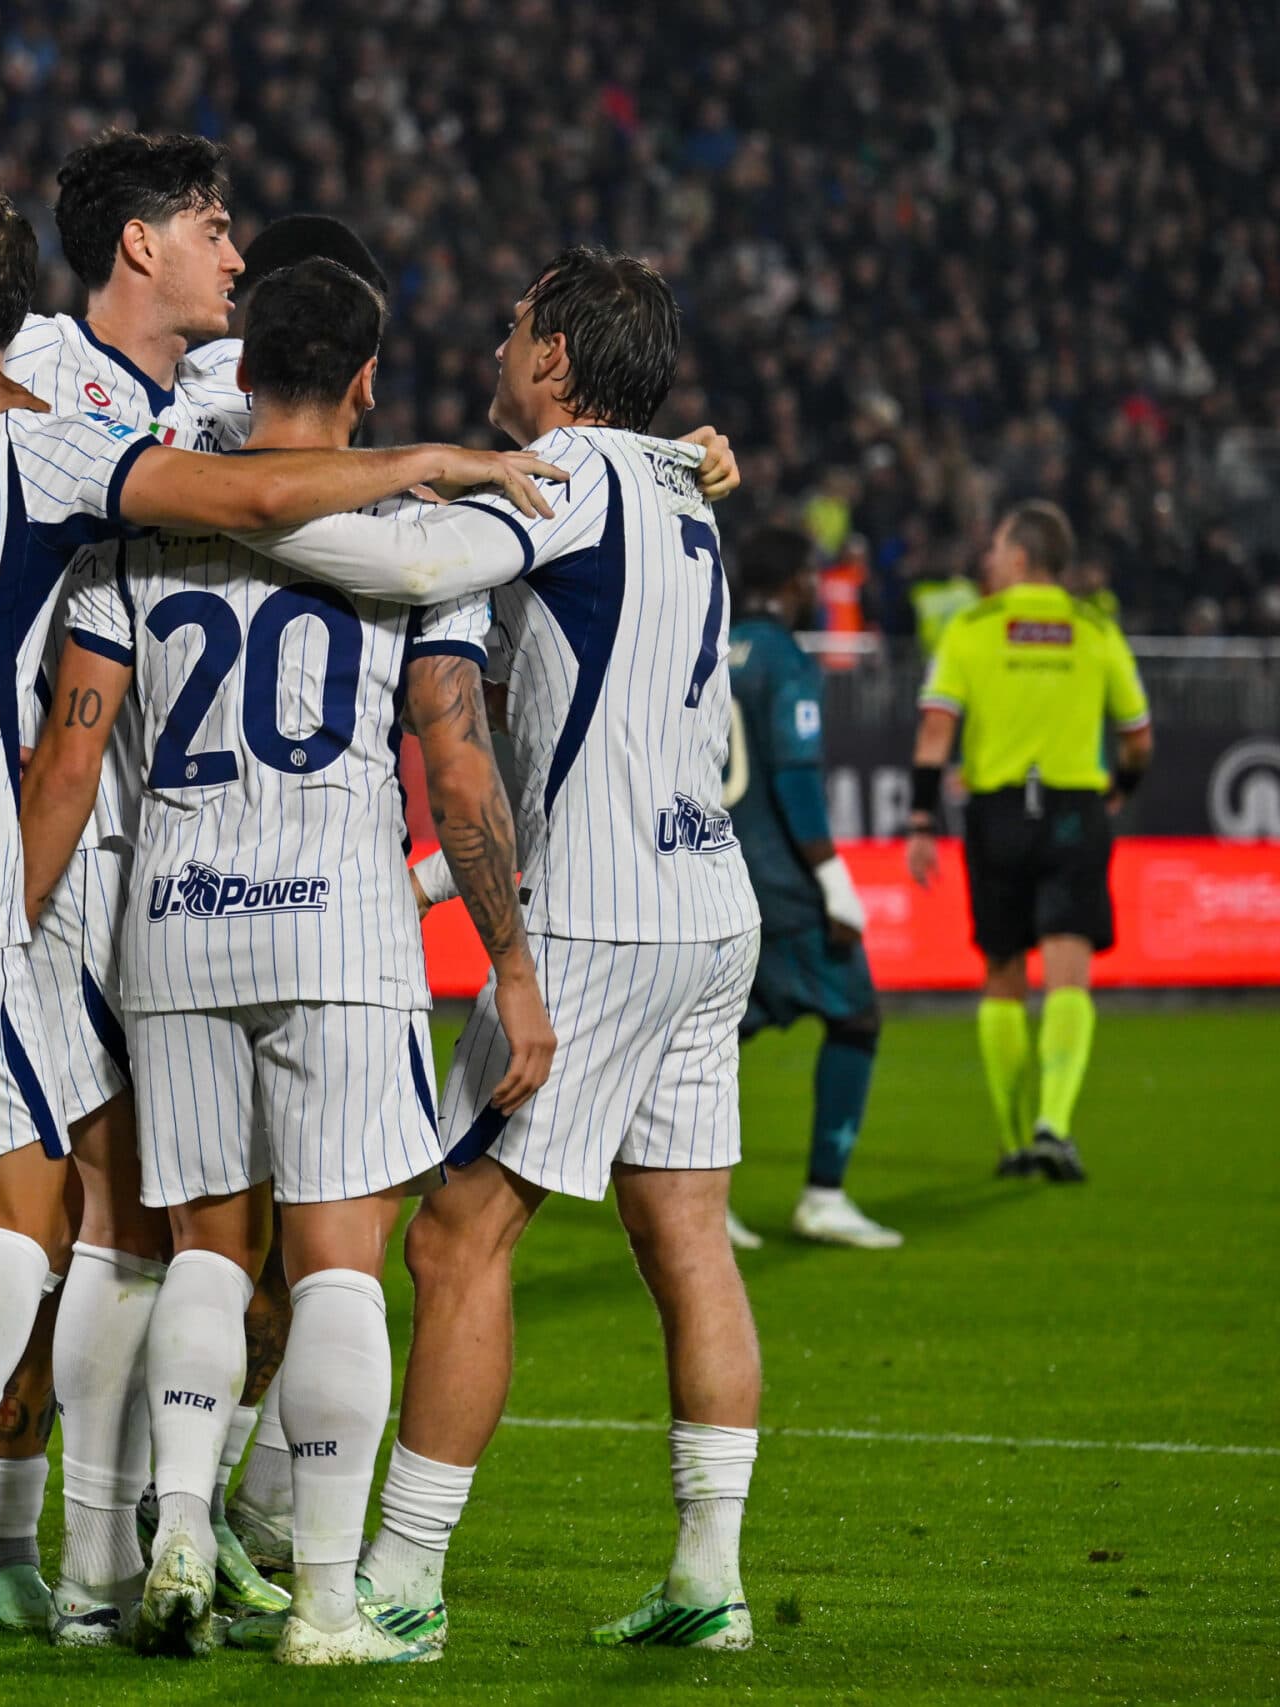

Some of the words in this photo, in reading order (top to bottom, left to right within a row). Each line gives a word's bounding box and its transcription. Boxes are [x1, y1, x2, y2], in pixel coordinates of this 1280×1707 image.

[677, 514, 723, 708] 7
[144, 582, 363, 789] 20
[64, 687, 102, 729] 10
[218, 874, 329, 915] Power
[164, 1390, 217, 1412] INTER
[290, 1440, 337, 1459] INTER
